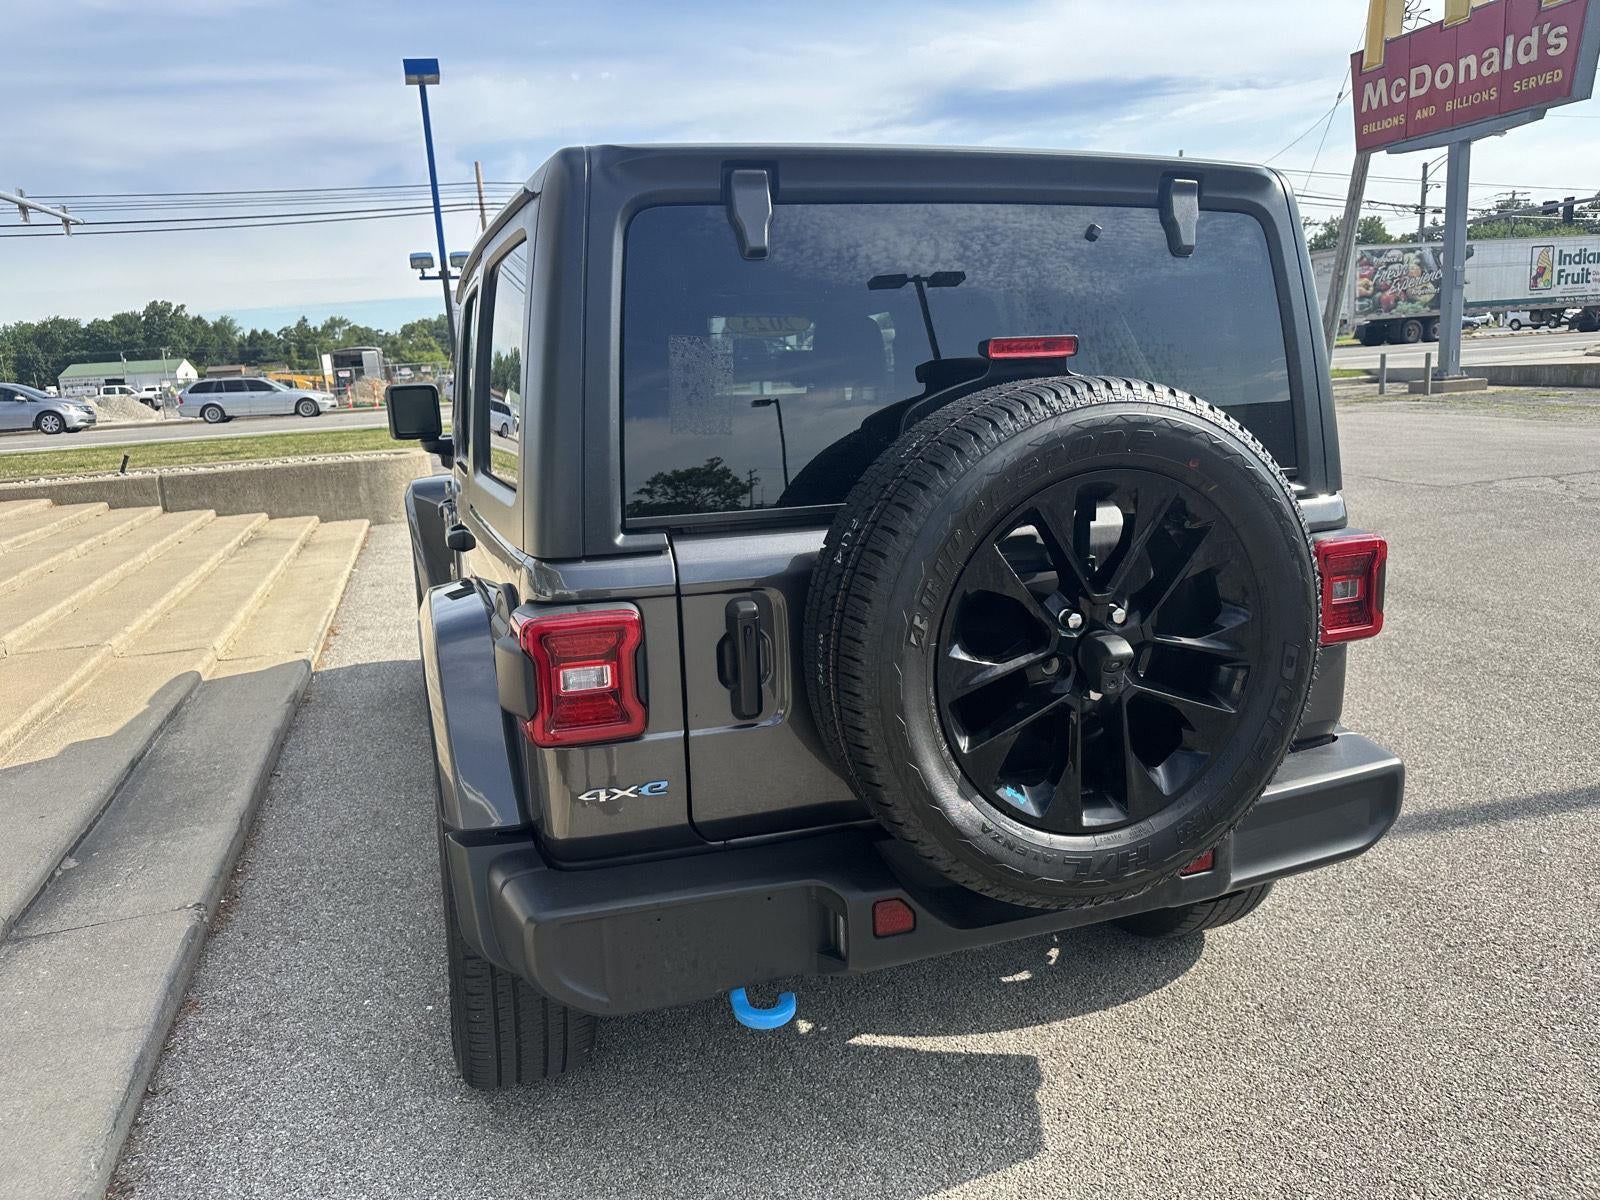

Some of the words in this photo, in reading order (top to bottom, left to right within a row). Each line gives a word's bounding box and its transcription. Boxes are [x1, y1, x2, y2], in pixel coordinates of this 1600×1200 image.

[1361, 22, 1568, 113] McDonald's
[1362, 113, 1405, 135] BILLIONS
[1415, 105, 1436, 120] AND
[1445, 87, 1497, 112] BILLIONS
[1513, 69, 1563, 93] SERVED
[1372, 259, 1409, 285] Fresh
[1387, 268, 1443, 296] Experienc
[1557, 267, 1591, 285] Fruit
[578, 779, 669, 802] 4xe
[980, 821, 1057, 864] ALENZA
